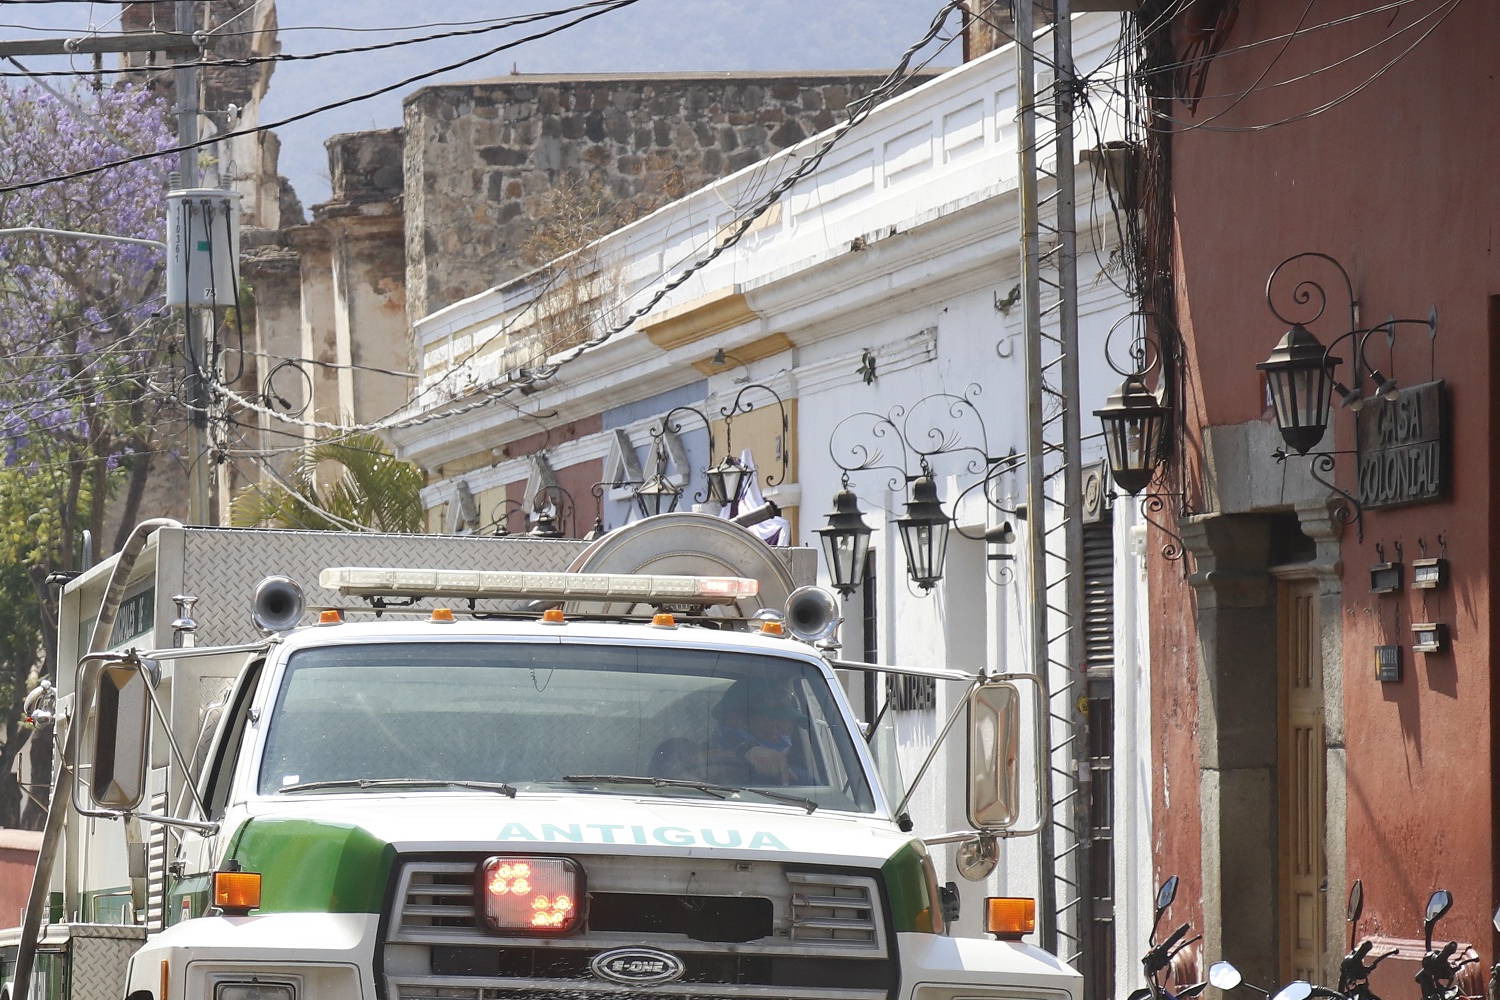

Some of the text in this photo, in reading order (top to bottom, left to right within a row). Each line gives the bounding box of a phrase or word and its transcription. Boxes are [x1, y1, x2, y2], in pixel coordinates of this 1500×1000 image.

[1378, 391, 1421, 446] CASA
[1359, 442, 1440, 504] COLONIAL
[496, 822, 791, 850] ANTIGUA
